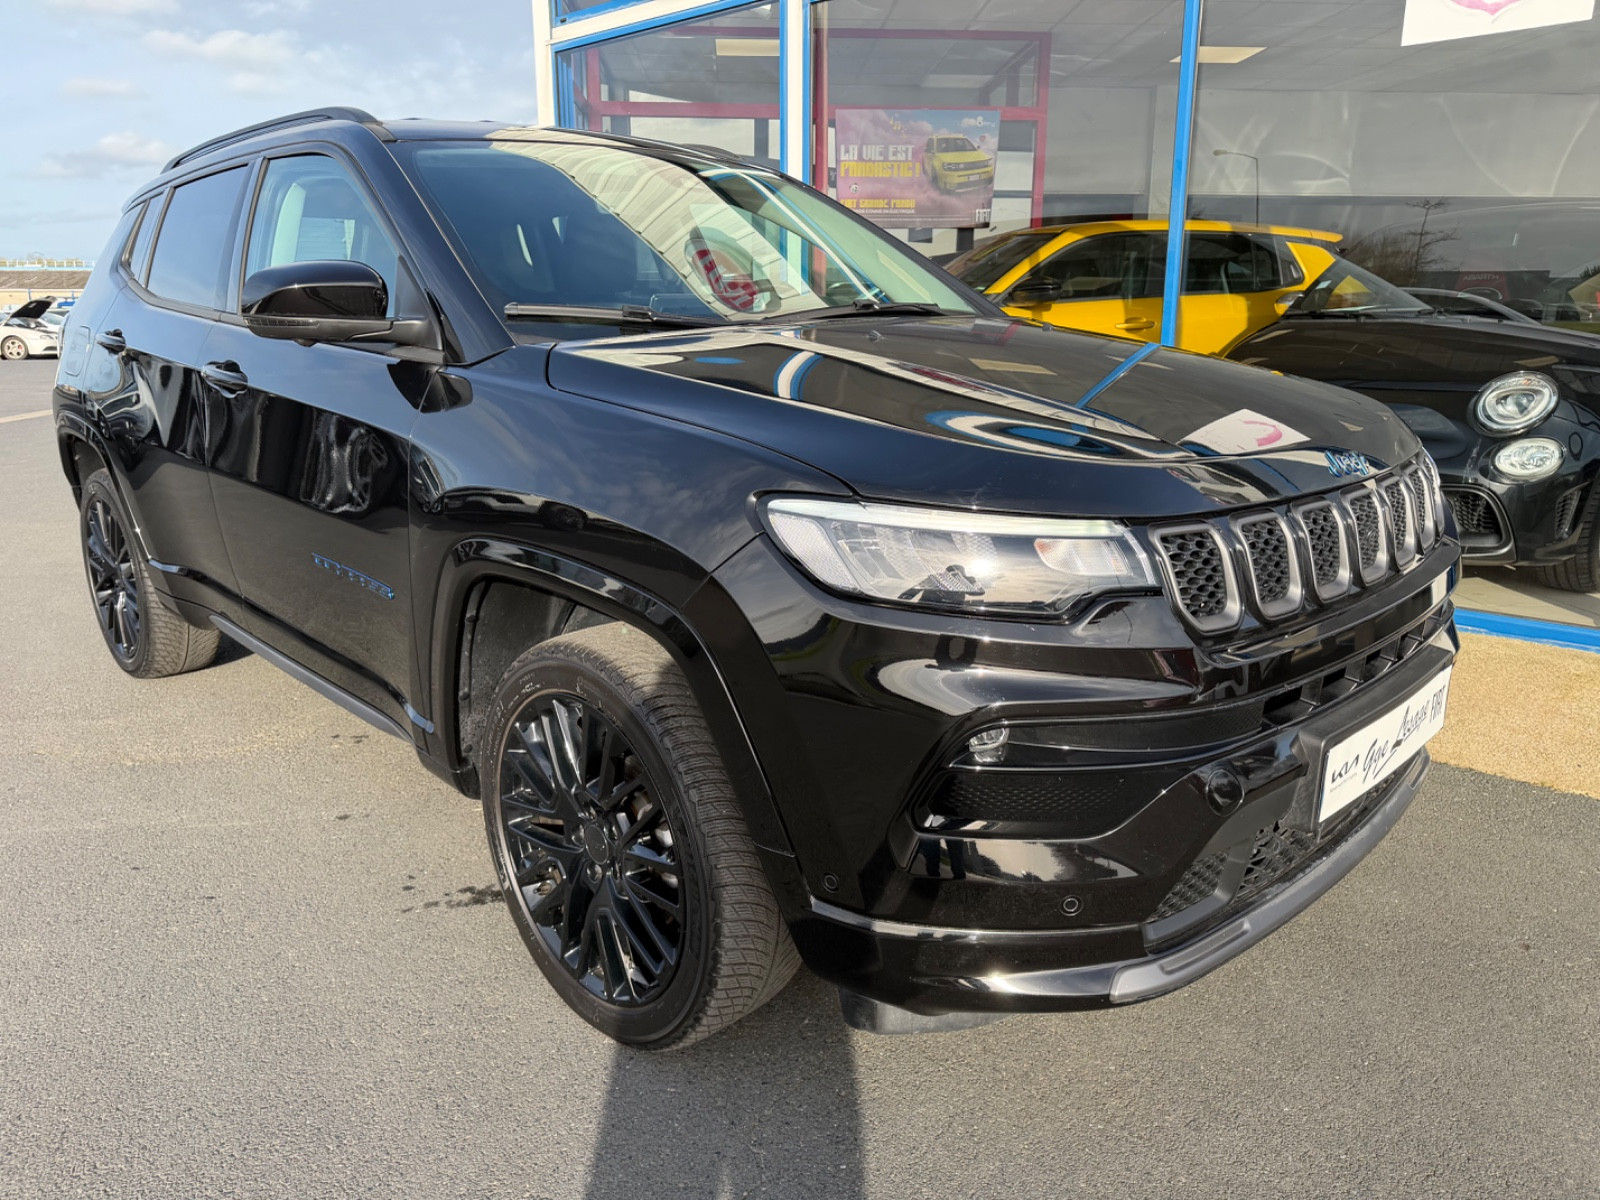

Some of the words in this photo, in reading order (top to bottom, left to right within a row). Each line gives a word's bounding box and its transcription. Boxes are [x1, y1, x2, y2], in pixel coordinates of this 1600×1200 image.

[840, 144, 858, 160] LA
[862, 144, 884, 160] VIE
[888, 144, 914, 160] EST
[840, 161, 913, 178] PANDASTIC
[859, 198, 890, 208] GRANDE
[892, 199, 916, 208] PANDA
[976, 208, 991, 223] FIAT
[1463, 273, 1499, 281] ABARTH
[1325, 450, 1369, 478] Jeep
